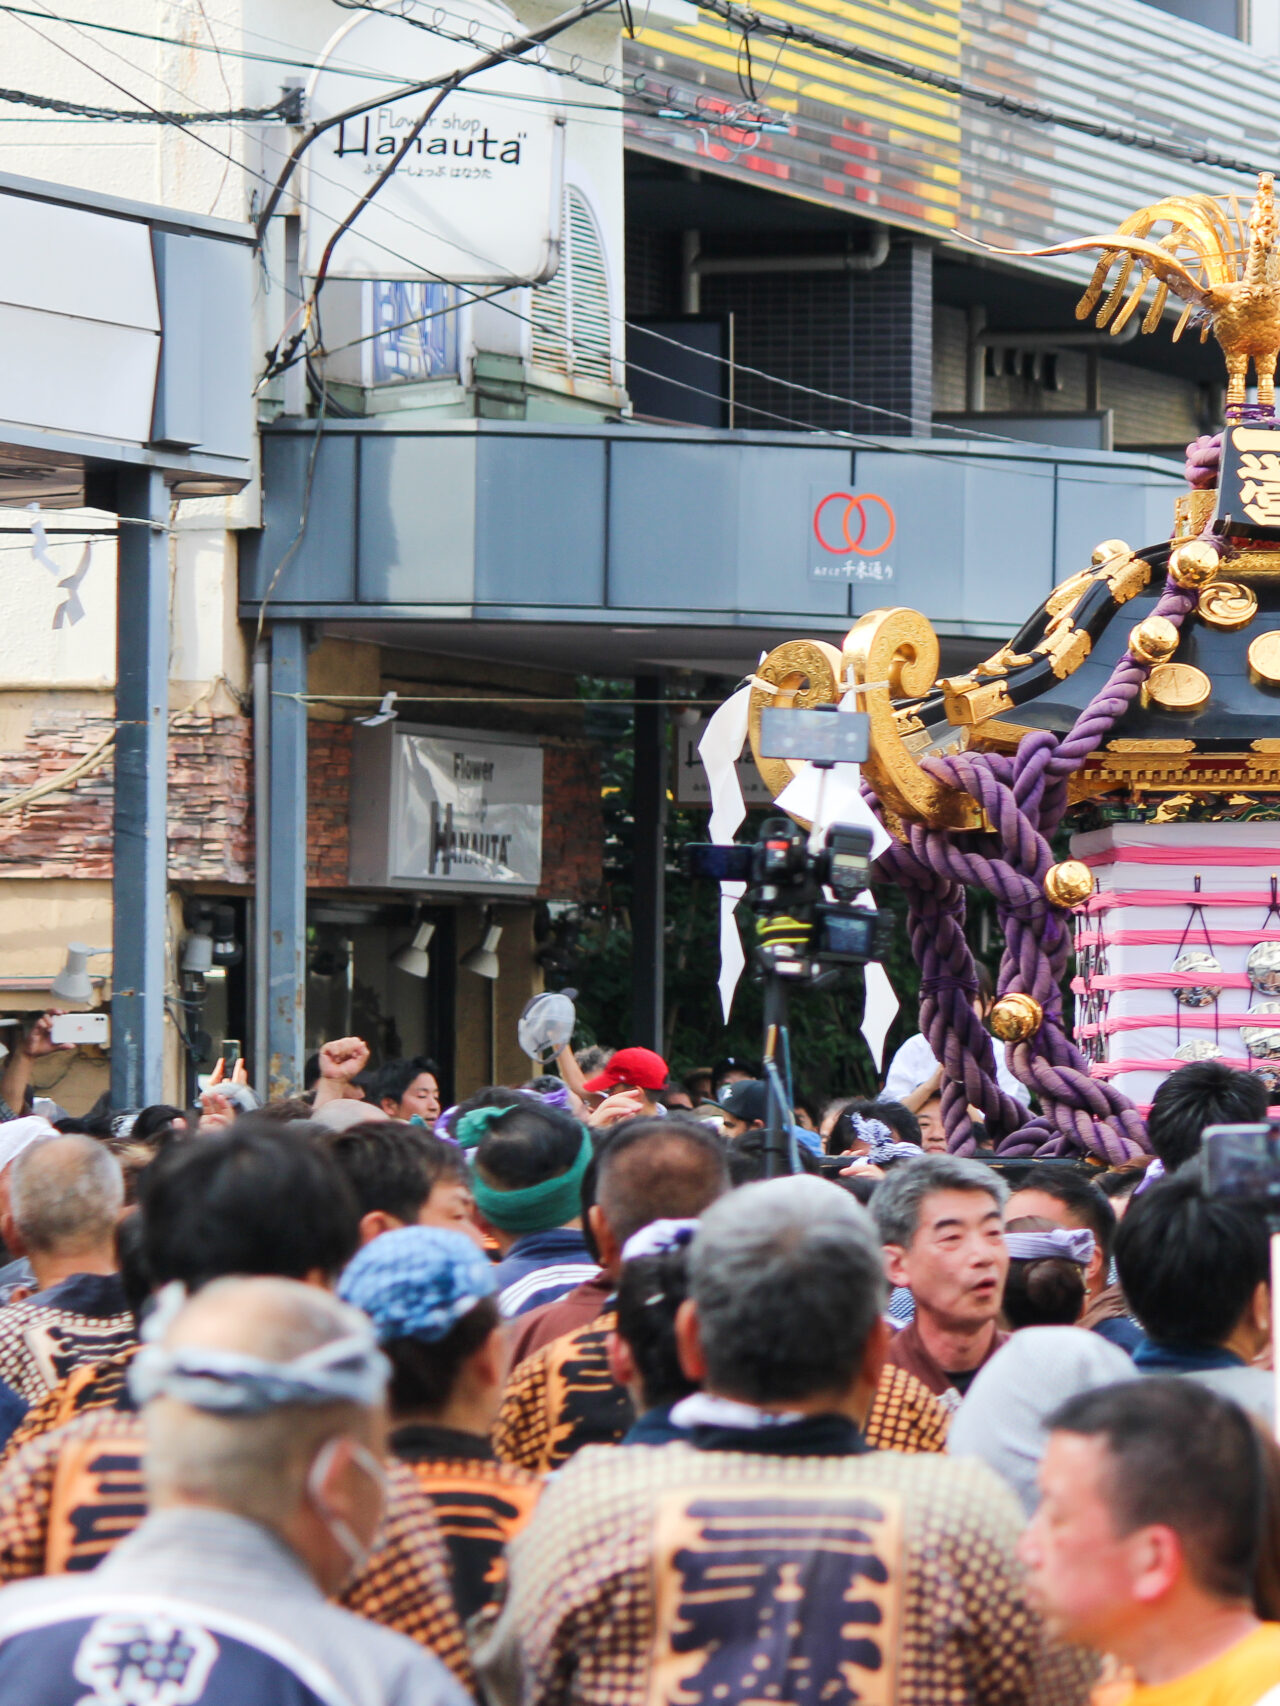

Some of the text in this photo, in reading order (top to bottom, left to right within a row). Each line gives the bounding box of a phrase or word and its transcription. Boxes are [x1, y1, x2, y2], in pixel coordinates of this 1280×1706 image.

[377, 107, 481, 137] Flowr shop
[363, 163, 445, 178] ふらーしょっぷ
[453, 752, 494, 782] Flower
